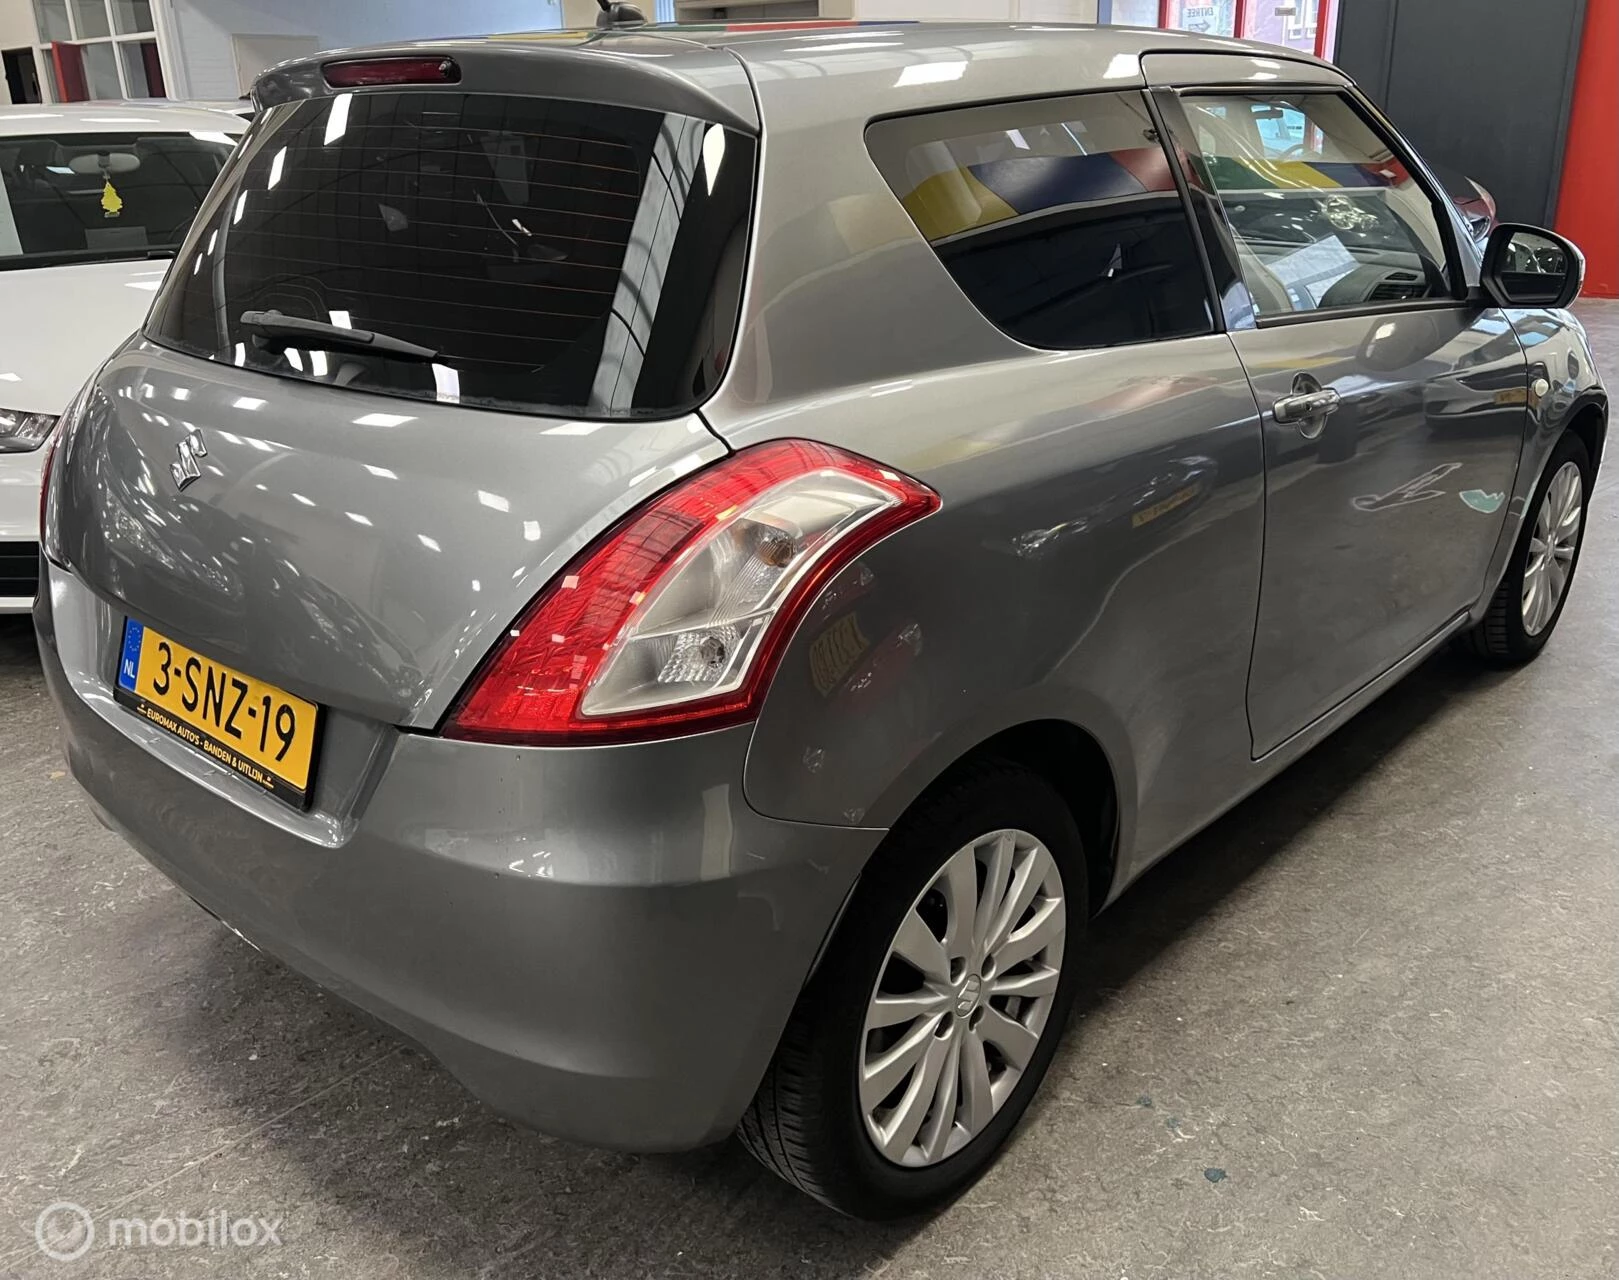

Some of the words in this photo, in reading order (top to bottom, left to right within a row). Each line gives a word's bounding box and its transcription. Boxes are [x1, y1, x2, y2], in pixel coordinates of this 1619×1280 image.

[123, 658, 136, 679] NL
[153, 642, 296, 762] 3-SNZ-19
[146, 707, 178, 733] EUROMAX
[177, 725, 200, 745] AUTO'S
[203, 740, 232, 764] BANDEN
[231, 757, 238, 768] &
